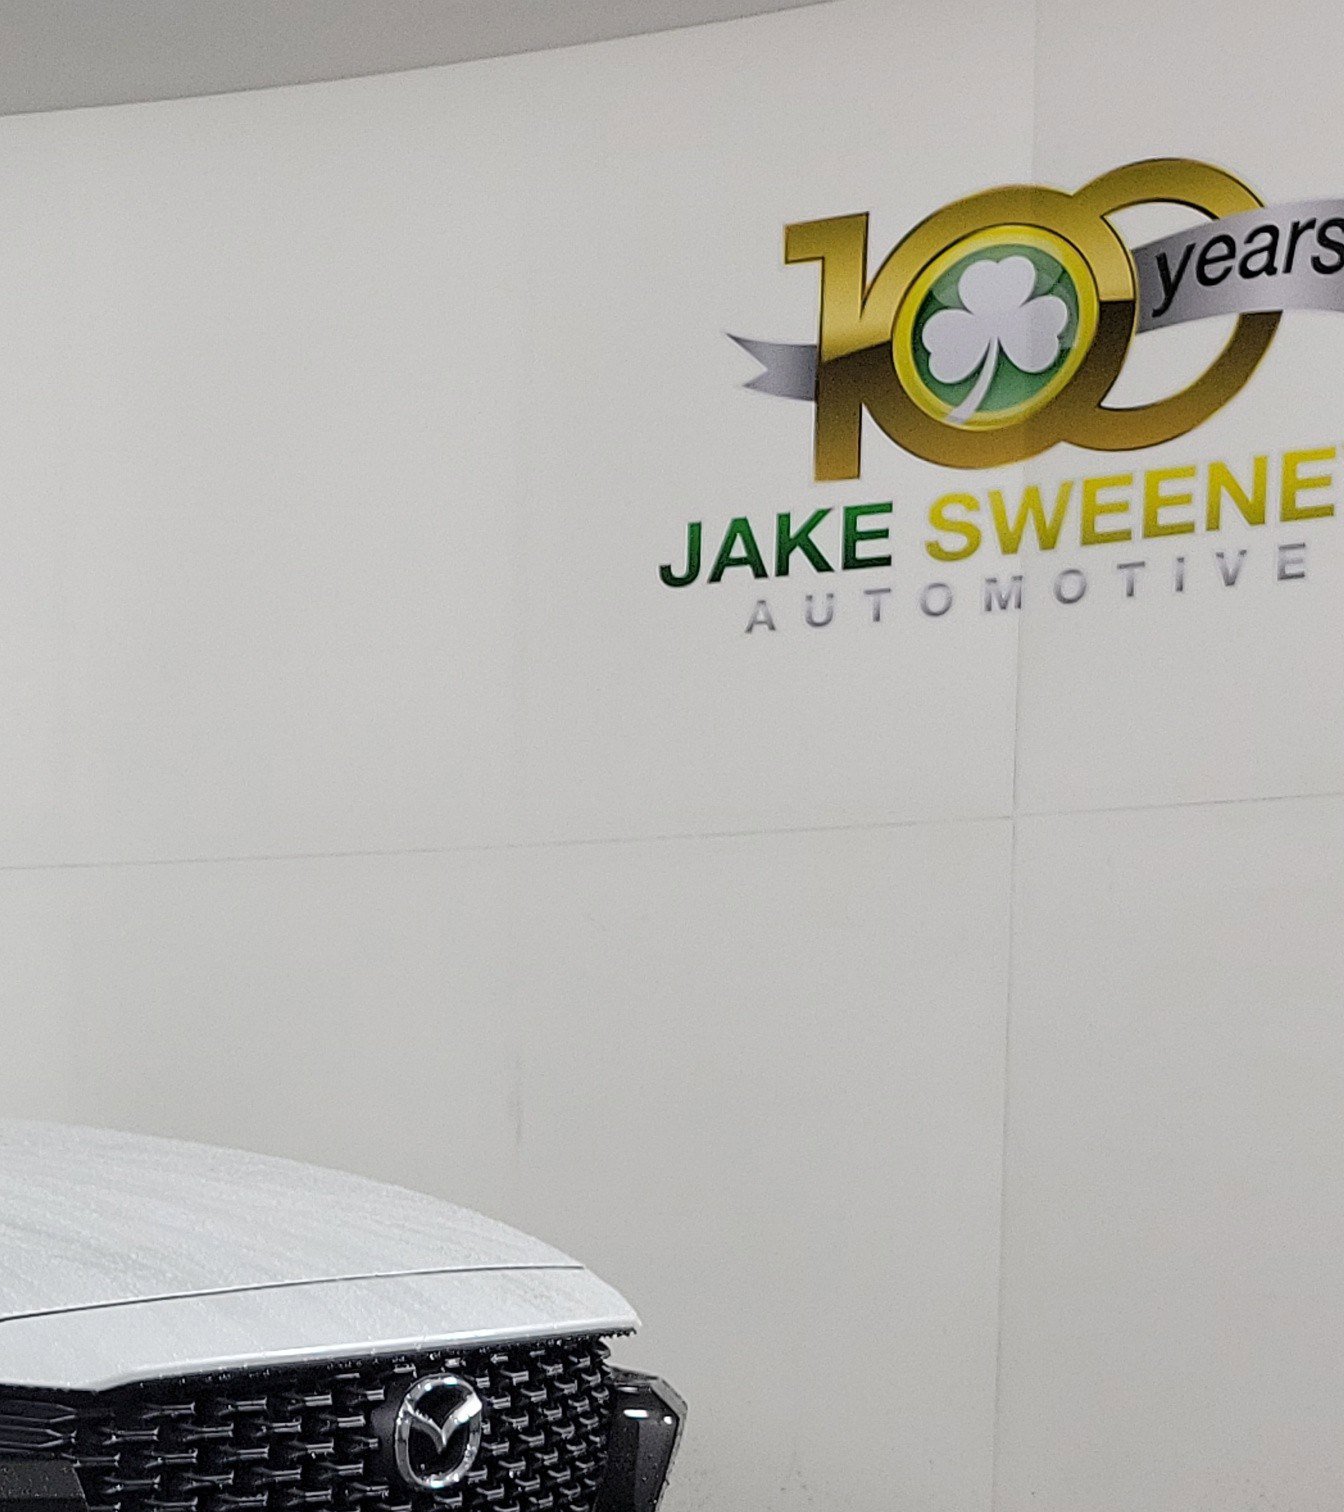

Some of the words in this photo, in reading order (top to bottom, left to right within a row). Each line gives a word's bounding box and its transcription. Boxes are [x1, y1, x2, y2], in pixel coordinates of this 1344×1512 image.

[784, 157, 1283, 481] 100
[1150, 216, 1344, 318] years
[659, 500, 894, 588] JAKE
[923, 446, 1344, 563] SWEENE
[745, 542, 1307, 633] AUTOMOTIVE
